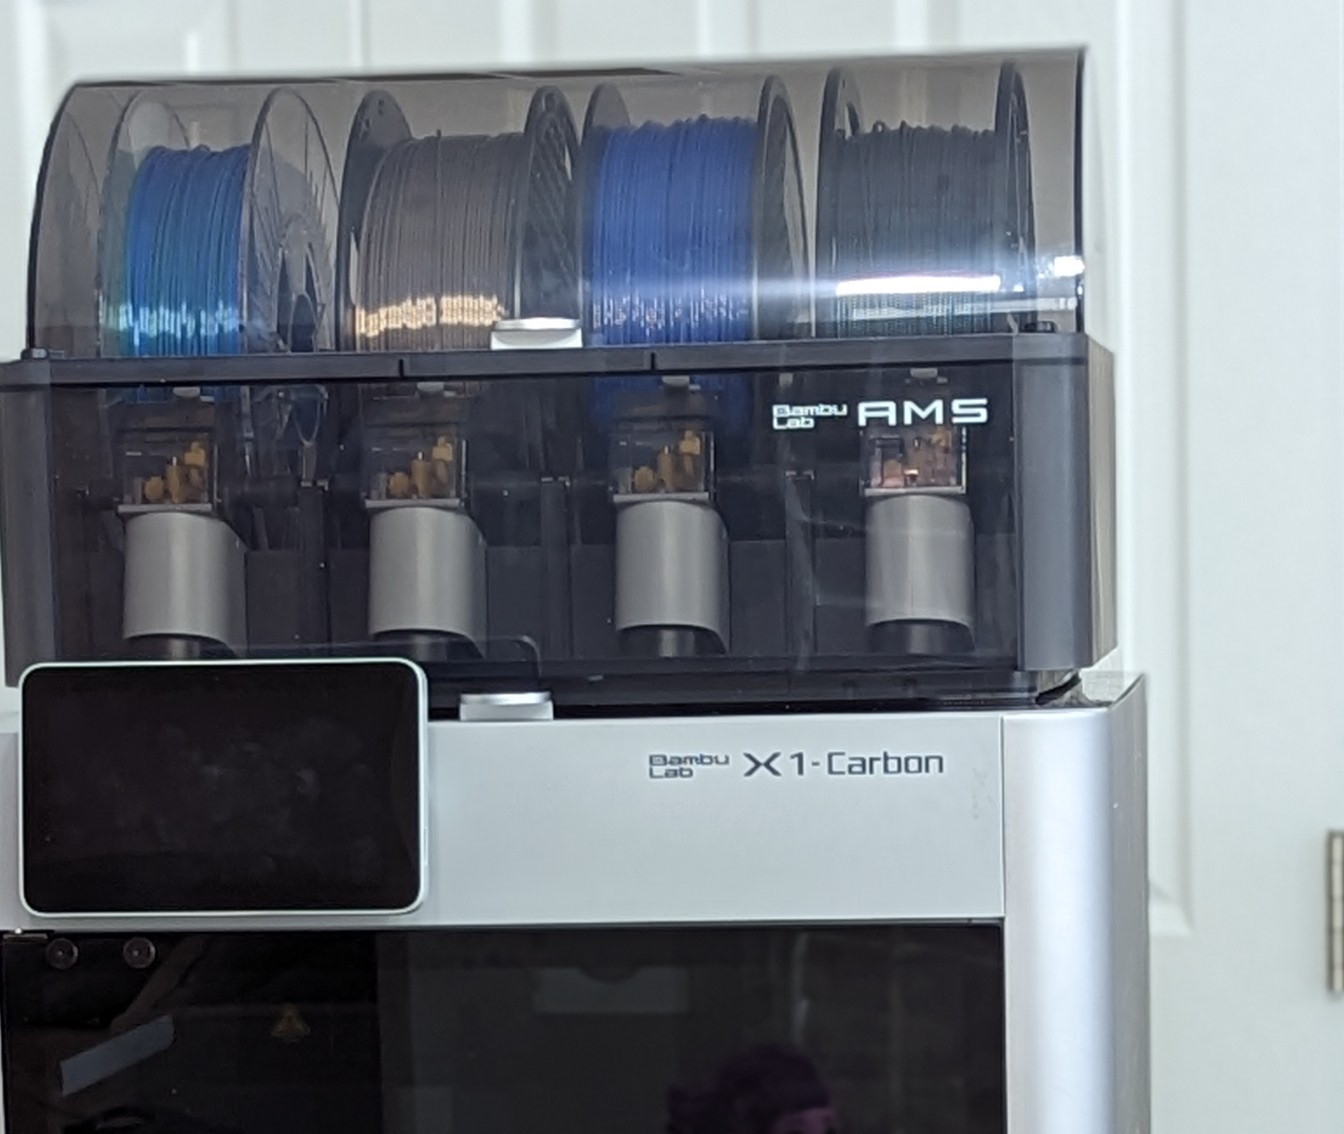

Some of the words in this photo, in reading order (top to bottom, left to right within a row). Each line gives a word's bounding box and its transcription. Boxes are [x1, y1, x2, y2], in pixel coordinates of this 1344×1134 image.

[772, 404, 848, 417] Bambu
[858, 398, 988, 426] AMS
[772, 417, 815, 430] Lab
[648, 753, 730, 766] Bambu
[648, 767, 694, 779] Lab
